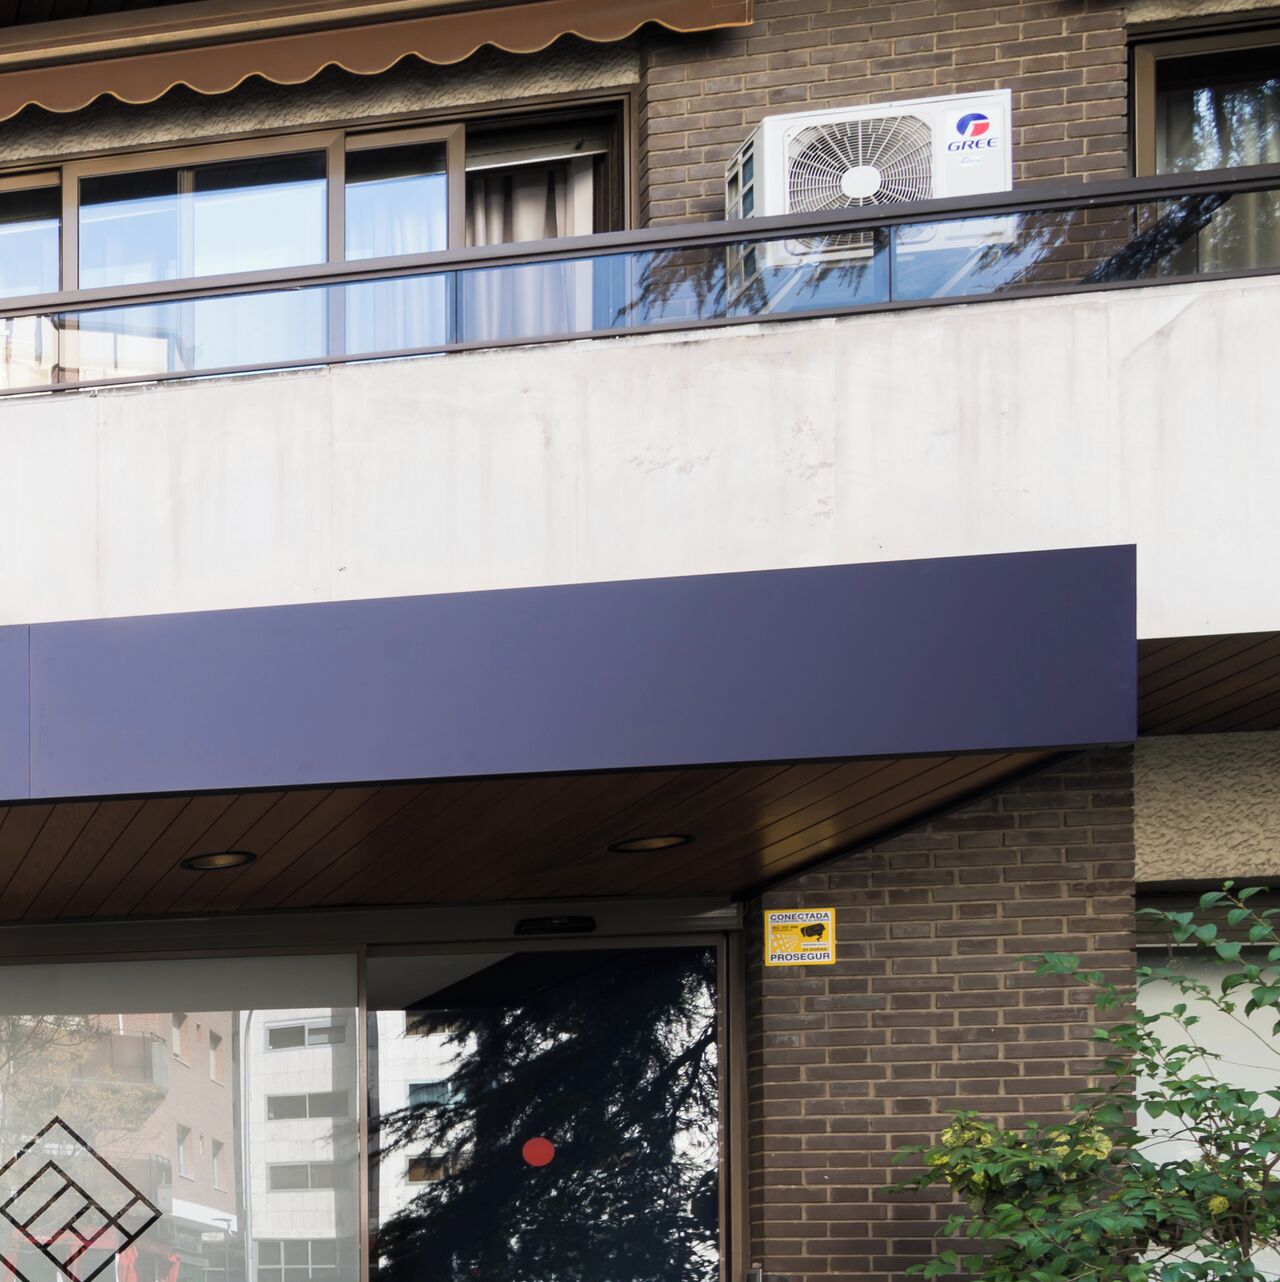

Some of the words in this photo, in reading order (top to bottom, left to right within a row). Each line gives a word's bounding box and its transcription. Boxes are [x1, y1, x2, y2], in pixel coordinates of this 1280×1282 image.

[947, 137, 999, 152] GREE
[770, 912, 830, 921] CONECTADA
[770, 952, 830, 961] PROSEGUR
